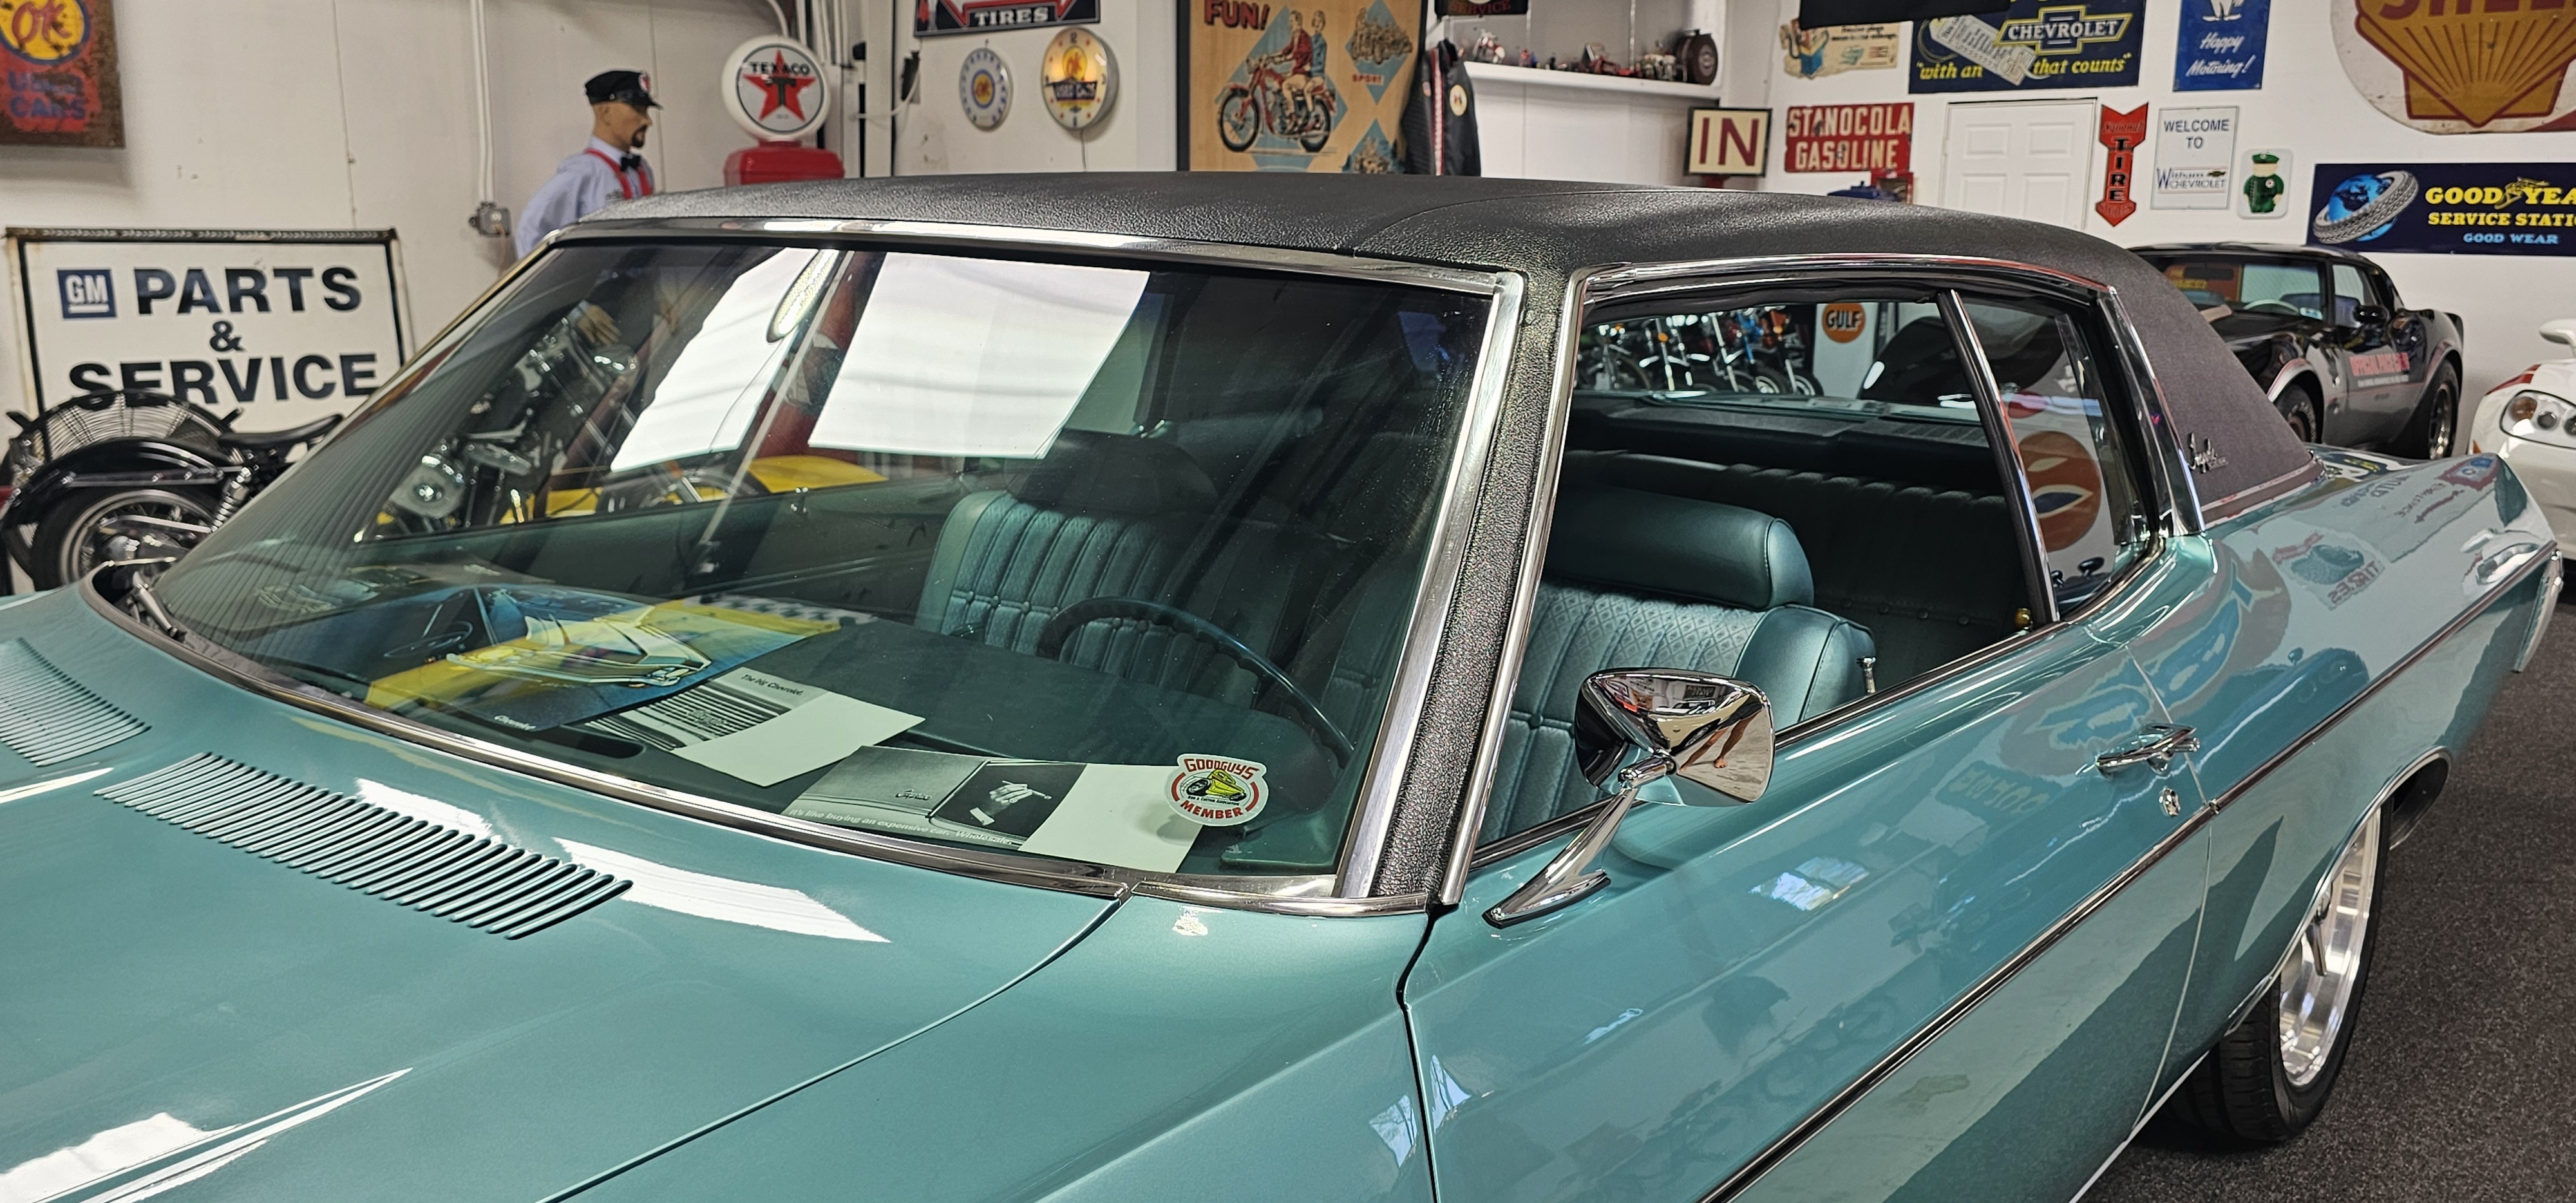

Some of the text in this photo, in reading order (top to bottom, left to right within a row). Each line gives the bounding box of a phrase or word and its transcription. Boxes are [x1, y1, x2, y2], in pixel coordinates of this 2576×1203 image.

[974, 8, 1049, 26] TIRES
[1204, 0, 1270, 30] FUN!
[2007, 21, 2119, 40] CHEVROLET
[2199, 32, 2245, 54] Happy
[749, 61, 811, 75] TEXACO
[1960, 65, 1984, 79] an
[2033, 58, 2069, 75] that
[1787, 105, 1911, 137] STANOCOLA
[2164, 118, 2230, 133] WELCOME
[1700, 117, 1759, 167] IN
[2186, 136, 2204, 149] TO
[1795, 139, 1898, 171] GASOLINE
[2109, 137, 2128, 201] TIRE
[2170, 178, 2226, 189] CHEVROLET
[2428, 212, 2576, 227] SERVICE STATI
[2463, 232, 2559, 245] GOOD WEAR
[67, 267, 362, 315] GM PARTS
[1826, 310, 1863, 332] GULF
[209, 321, 246, 352] &
[69, 354, 382, 404] SERVICE
[741, 674, 756, 683] The
[1184, 758, 1260, 780] GOODGUYS
[1180, 800, 1244, 819] MEMBER
[805, 810, 826, 819] like
[826, 813, 862, 824] buying
[876, 820, 929, 833] expensive
